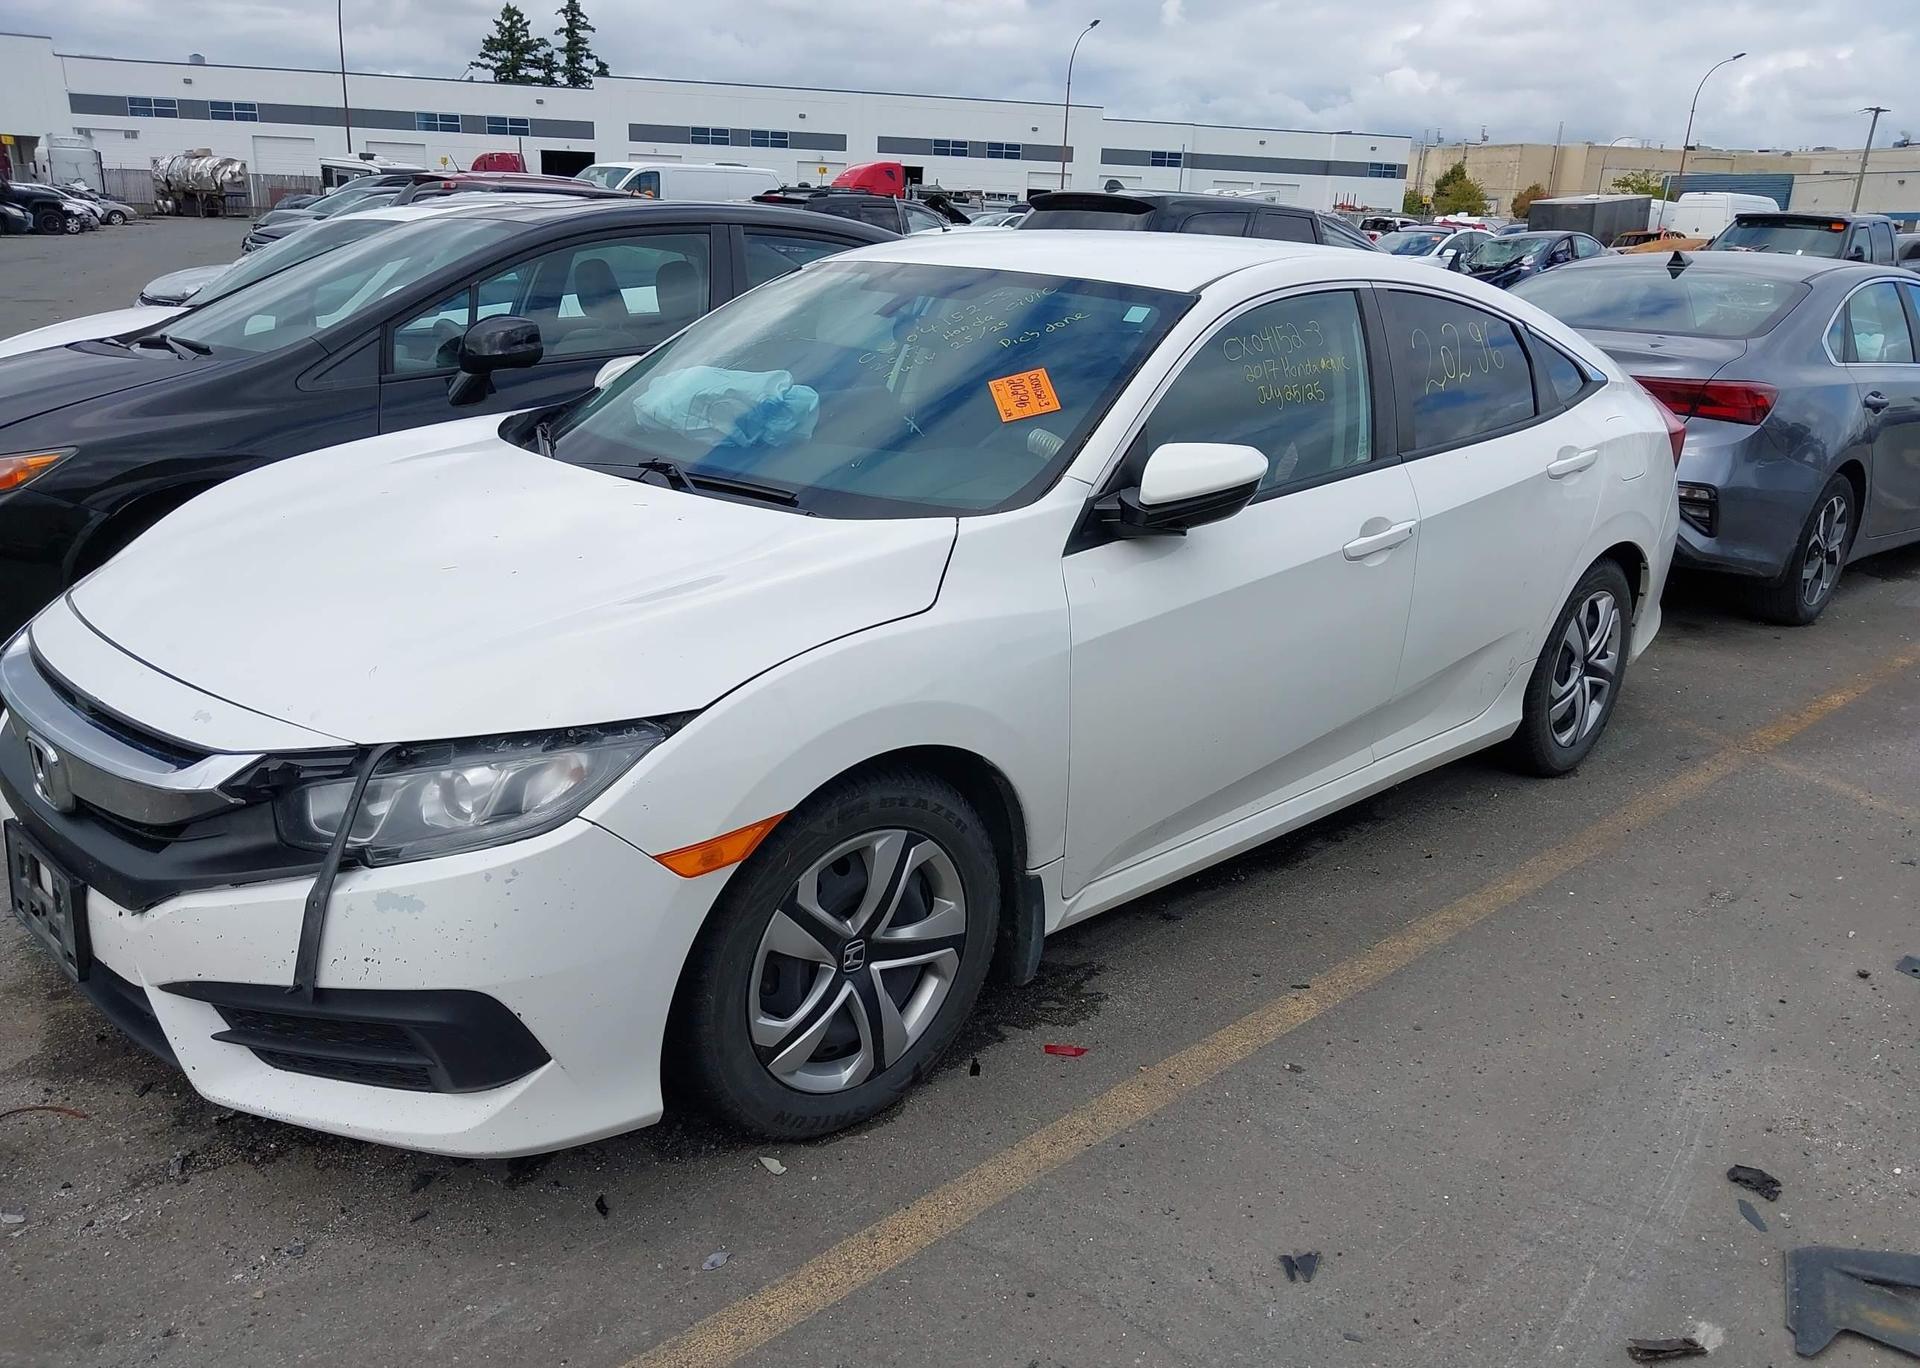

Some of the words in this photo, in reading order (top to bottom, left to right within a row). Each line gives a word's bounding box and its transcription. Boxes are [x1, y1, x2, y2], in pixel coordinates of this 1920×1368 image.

[1045, 310, 1091, 333] done
[1244, 359, 1279, 383] 2017
[1411, 321, 1505, 395] 20296
[1258, 385, 1284, 410] July
[1285, 381, 1325, 405] 25/25
[880, 796, 968, 834] BLAZER
